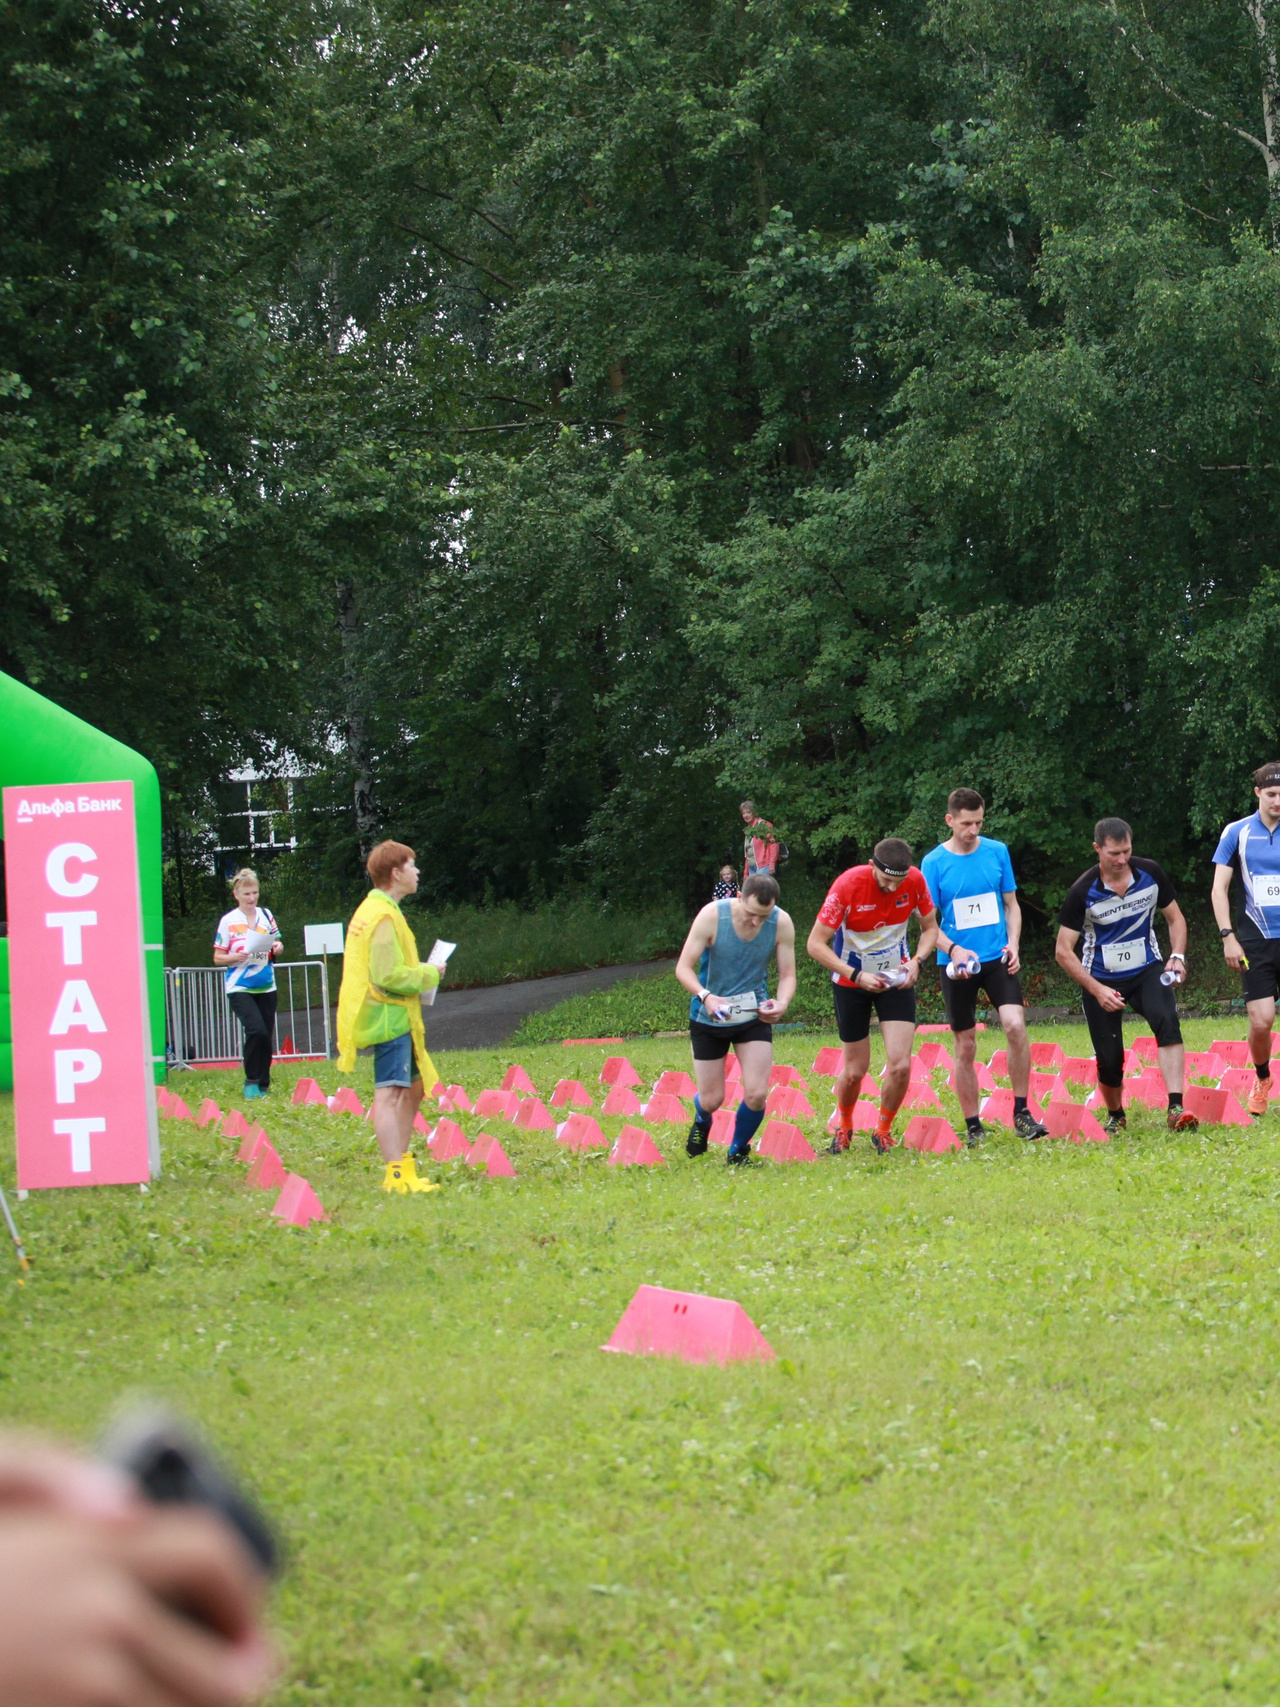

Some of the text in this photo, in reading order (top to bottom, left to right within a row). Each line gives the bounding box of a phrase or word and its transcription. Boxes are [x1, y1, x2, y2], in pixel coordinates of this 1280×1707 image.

[17, 796, 122, 818] Альфа Банк
[1267, 886, 1280, 896] 69
[968, 903, 981, 914] 71
[1117, 951, 1131, 962] 70
[876, 960, 890, 971] 72
[45, 842, 108, 1172] СТАРТ
